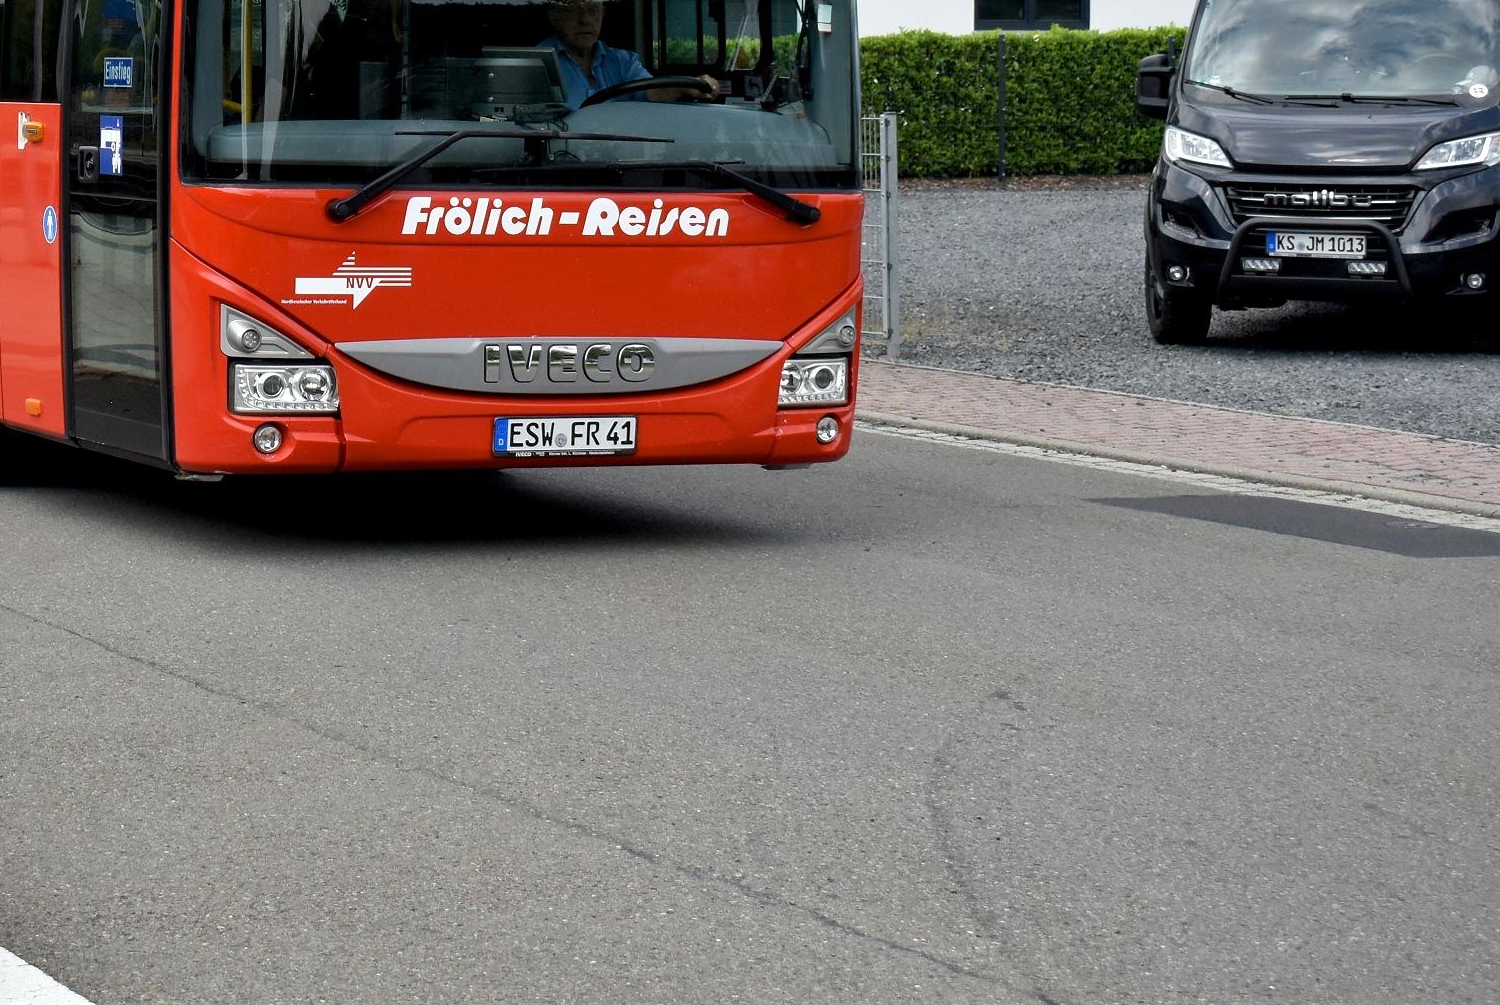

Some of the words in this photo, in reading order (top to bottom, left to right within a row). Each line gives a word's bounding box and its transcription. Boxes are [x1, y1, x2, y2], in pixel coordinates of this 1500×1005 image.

[105, 61, 131, 84] Einstieg
[1263, 189, 1372, 207] malibu
[1277, 236, 1295, 250] KS
[1306, 236, 1324, 252] JM
[1328, 237, 1364, 253] 1013
[346, 277, 374, 289] NVV
[483, 343, 656, 384] IVECO
[509, 421, 555, 448] ESW
[570, 421, 600, 447] FR
[606, 420, 633, 446] 41
